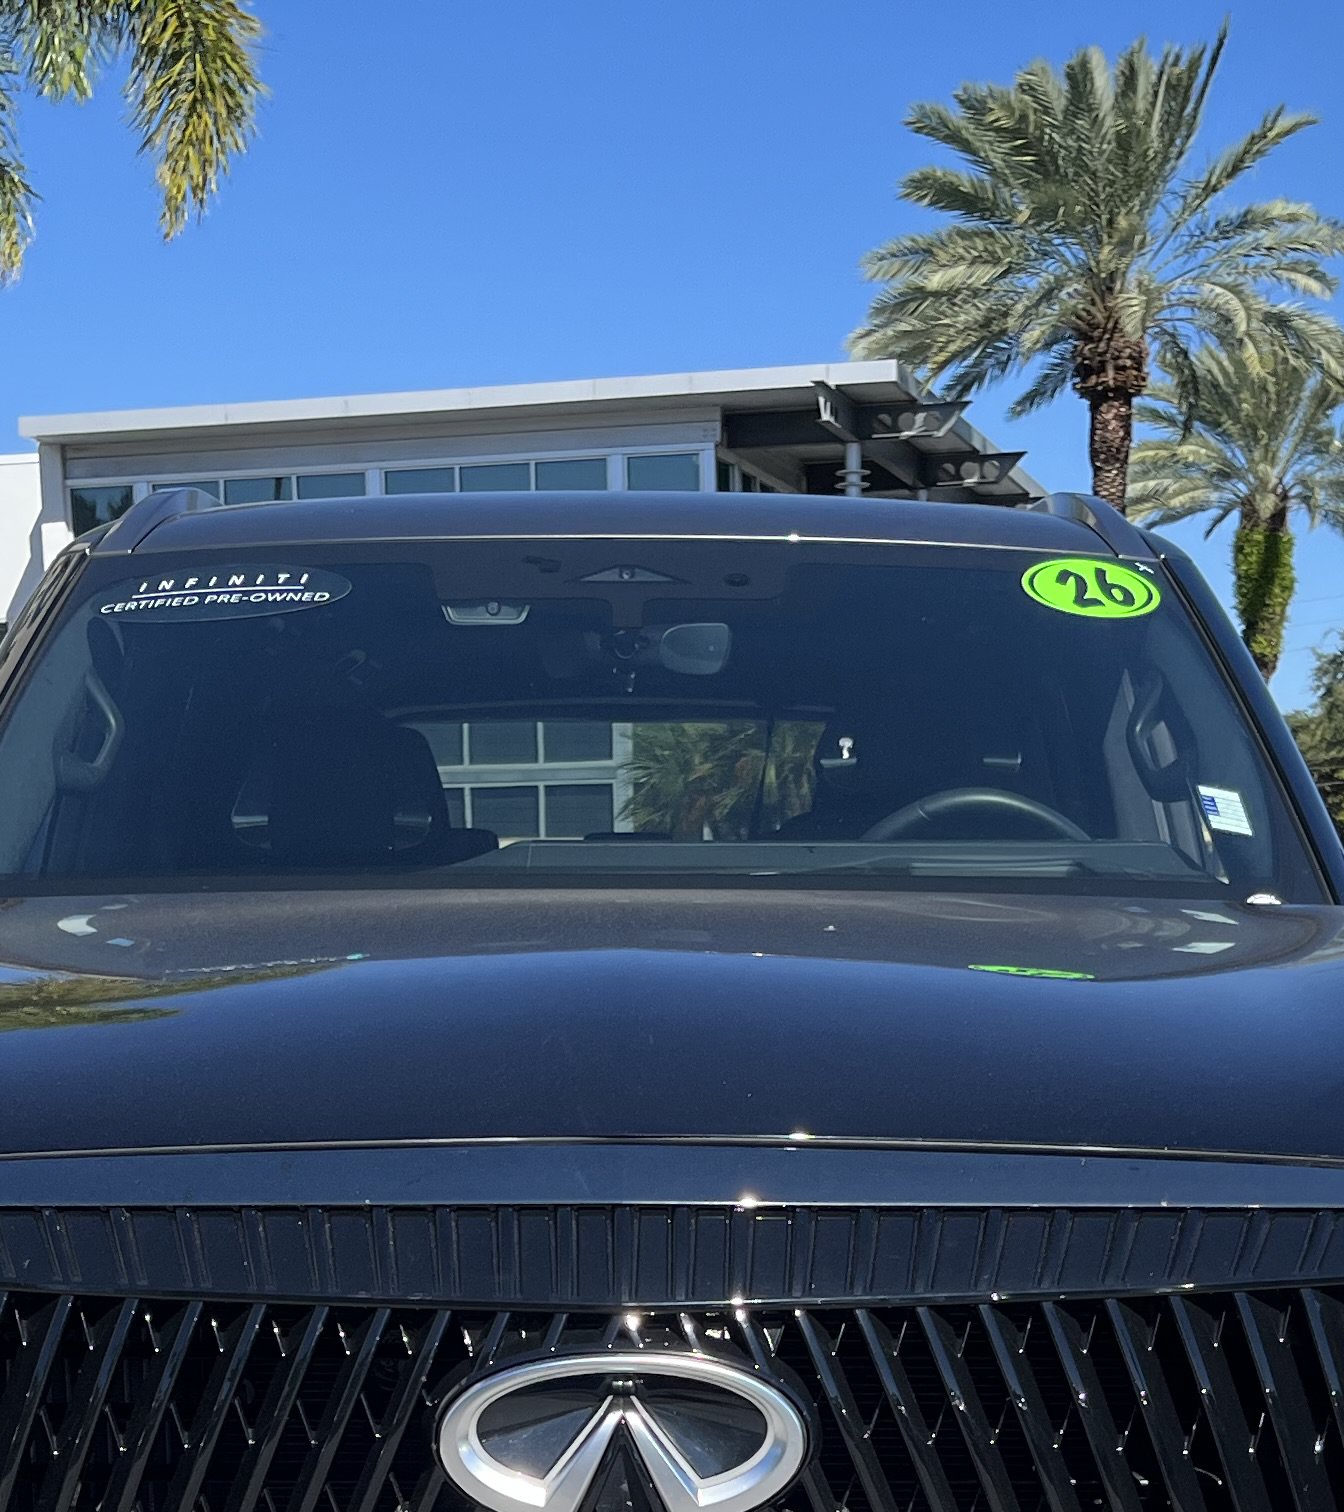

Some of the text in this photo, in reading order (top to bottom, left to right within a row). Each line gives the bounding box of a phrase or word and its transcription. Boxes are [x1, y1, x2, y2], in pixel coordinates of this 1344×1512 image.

[139, 572, 309, 593] INFINITI
[1055, 566, 1136, 608] 26
[100, 591, 331, 615] CERTIFIED PRE-OWNED
